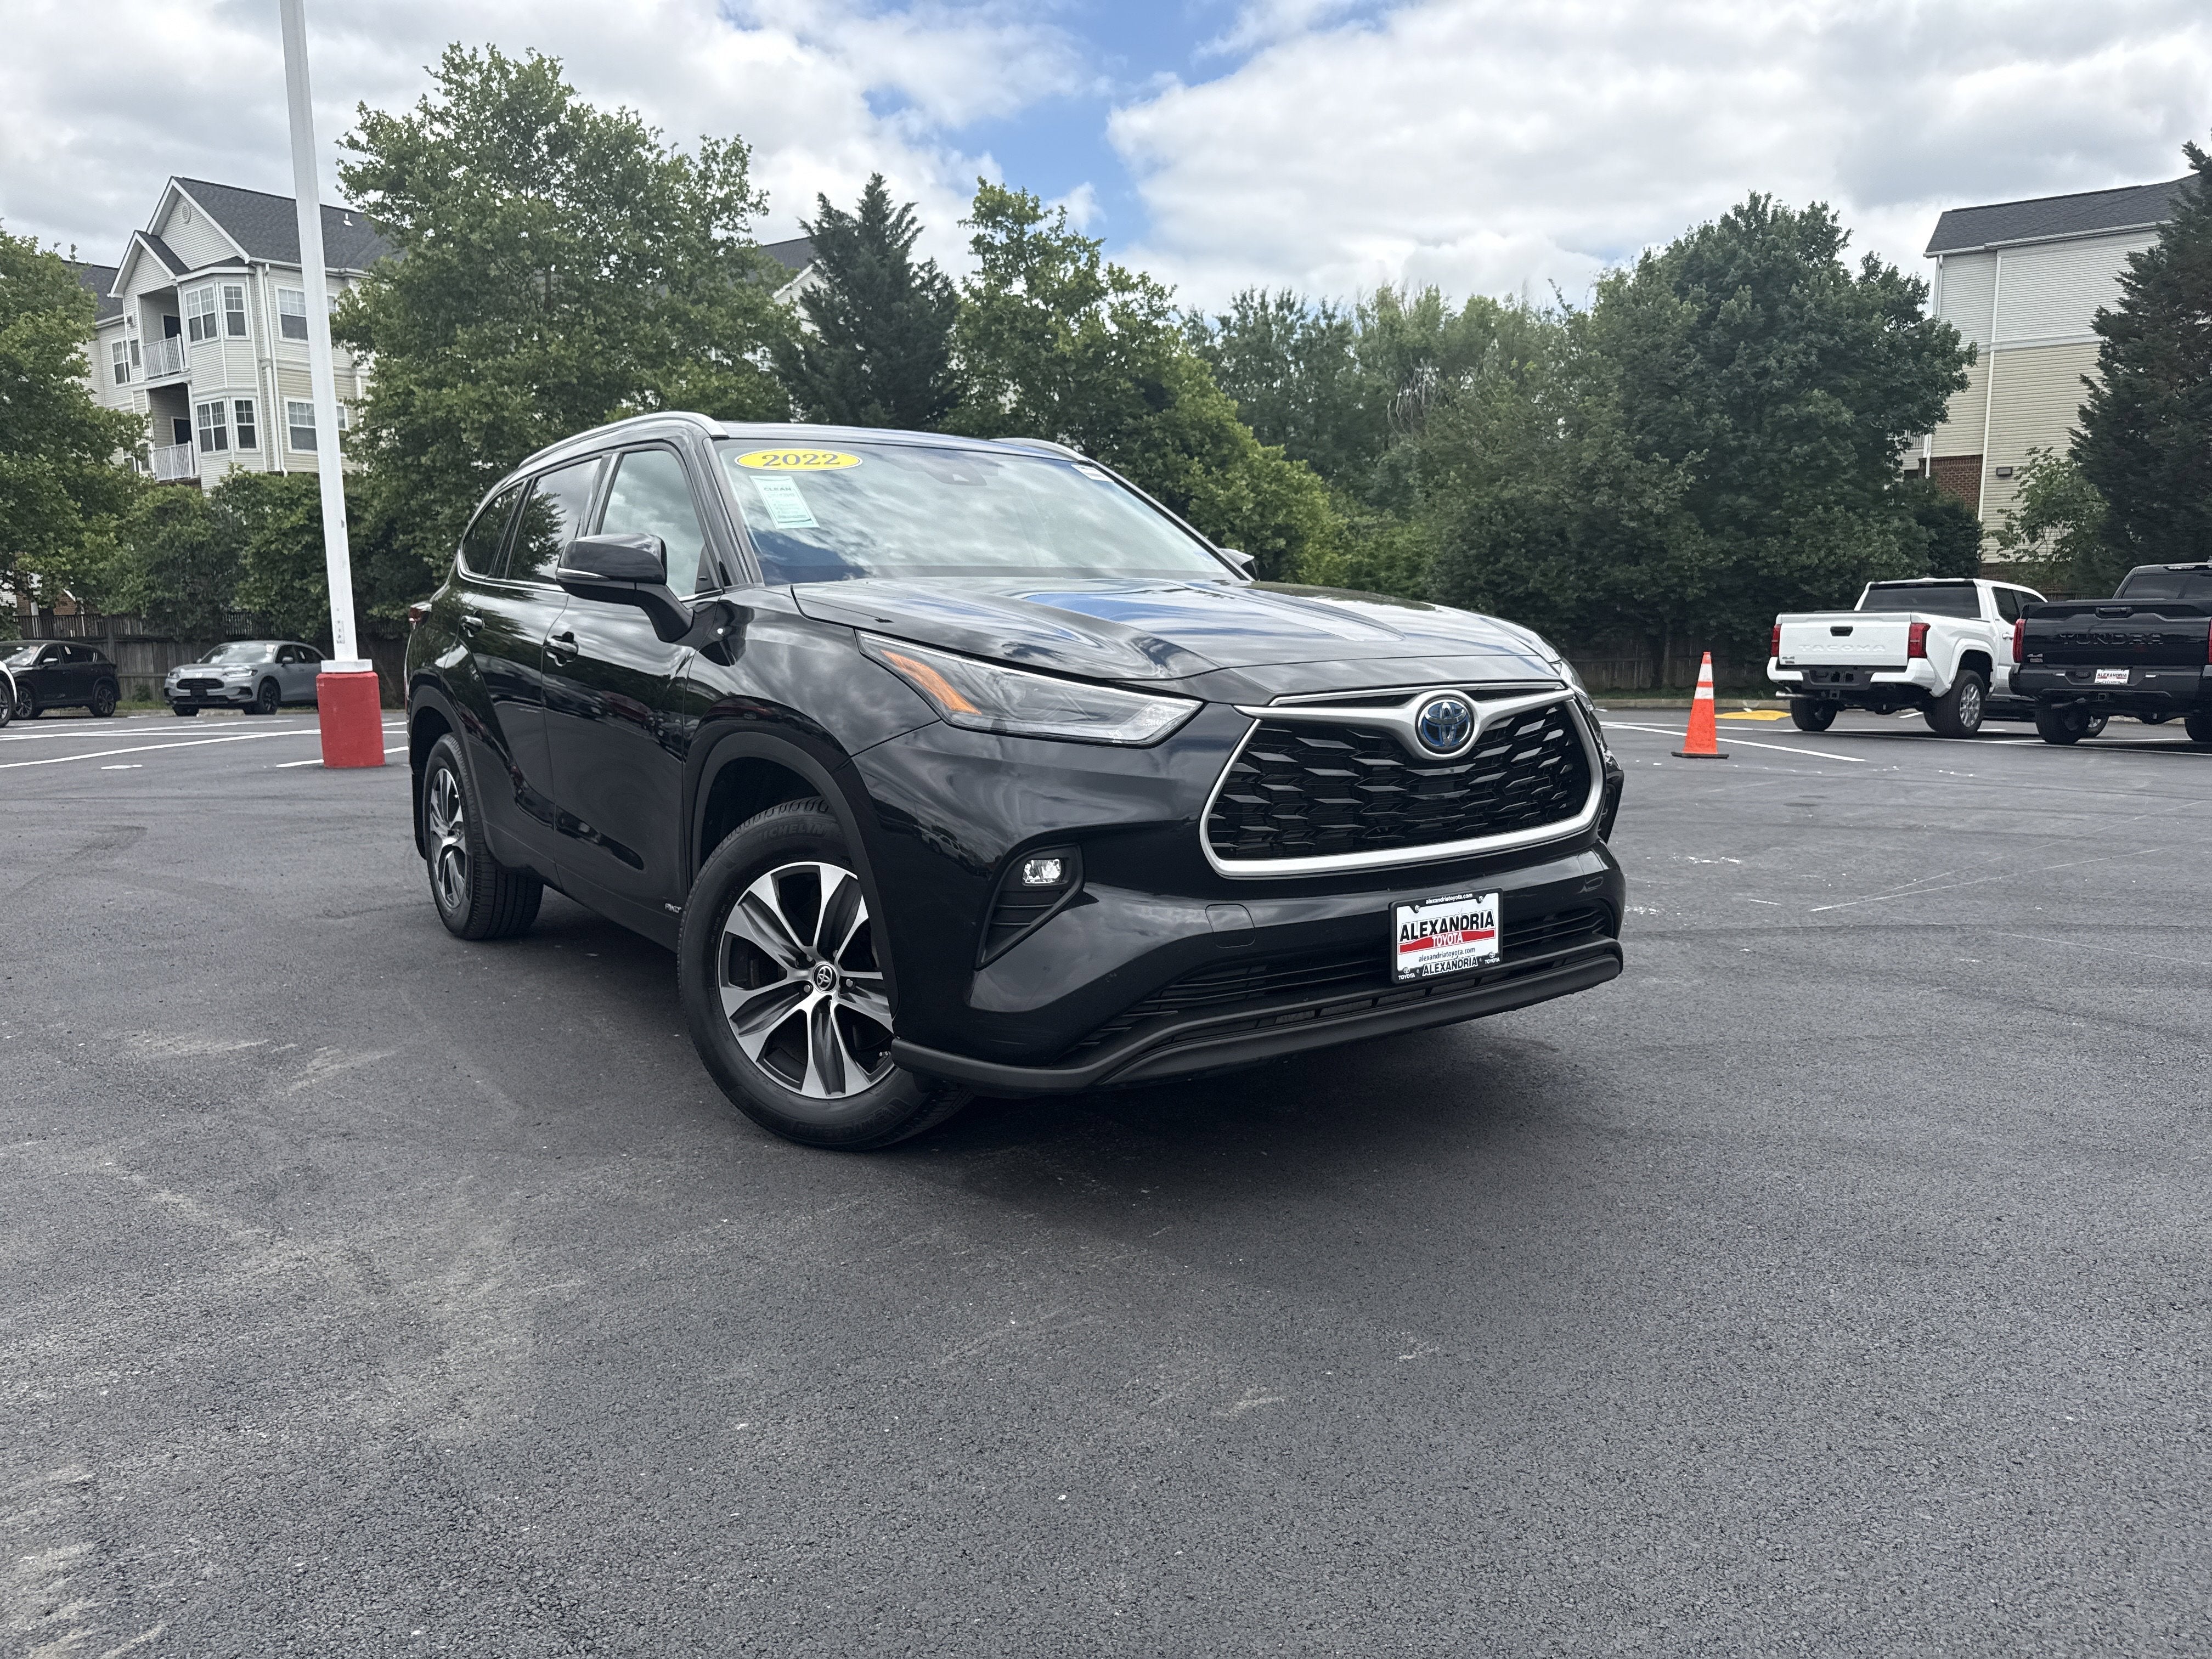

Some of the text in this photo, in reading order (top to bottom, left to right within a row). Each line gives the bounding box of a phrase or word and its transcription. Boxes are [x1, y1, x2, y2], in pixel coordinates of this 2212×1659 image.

[761, 453, 840, 467] 2022
[2059, 633, 2164, 645] TUNDRA
[1798, 644, 1886, 652] TACOMA
[1400, 911, 1494, 942] ALEXANDRIA
[1432, 932, 1464, 947] TOYOTA
[1418, 947, 1475, 963] alexandriatoyota.com
[1423, 956, 1478, 976] ALEXANDRIA
